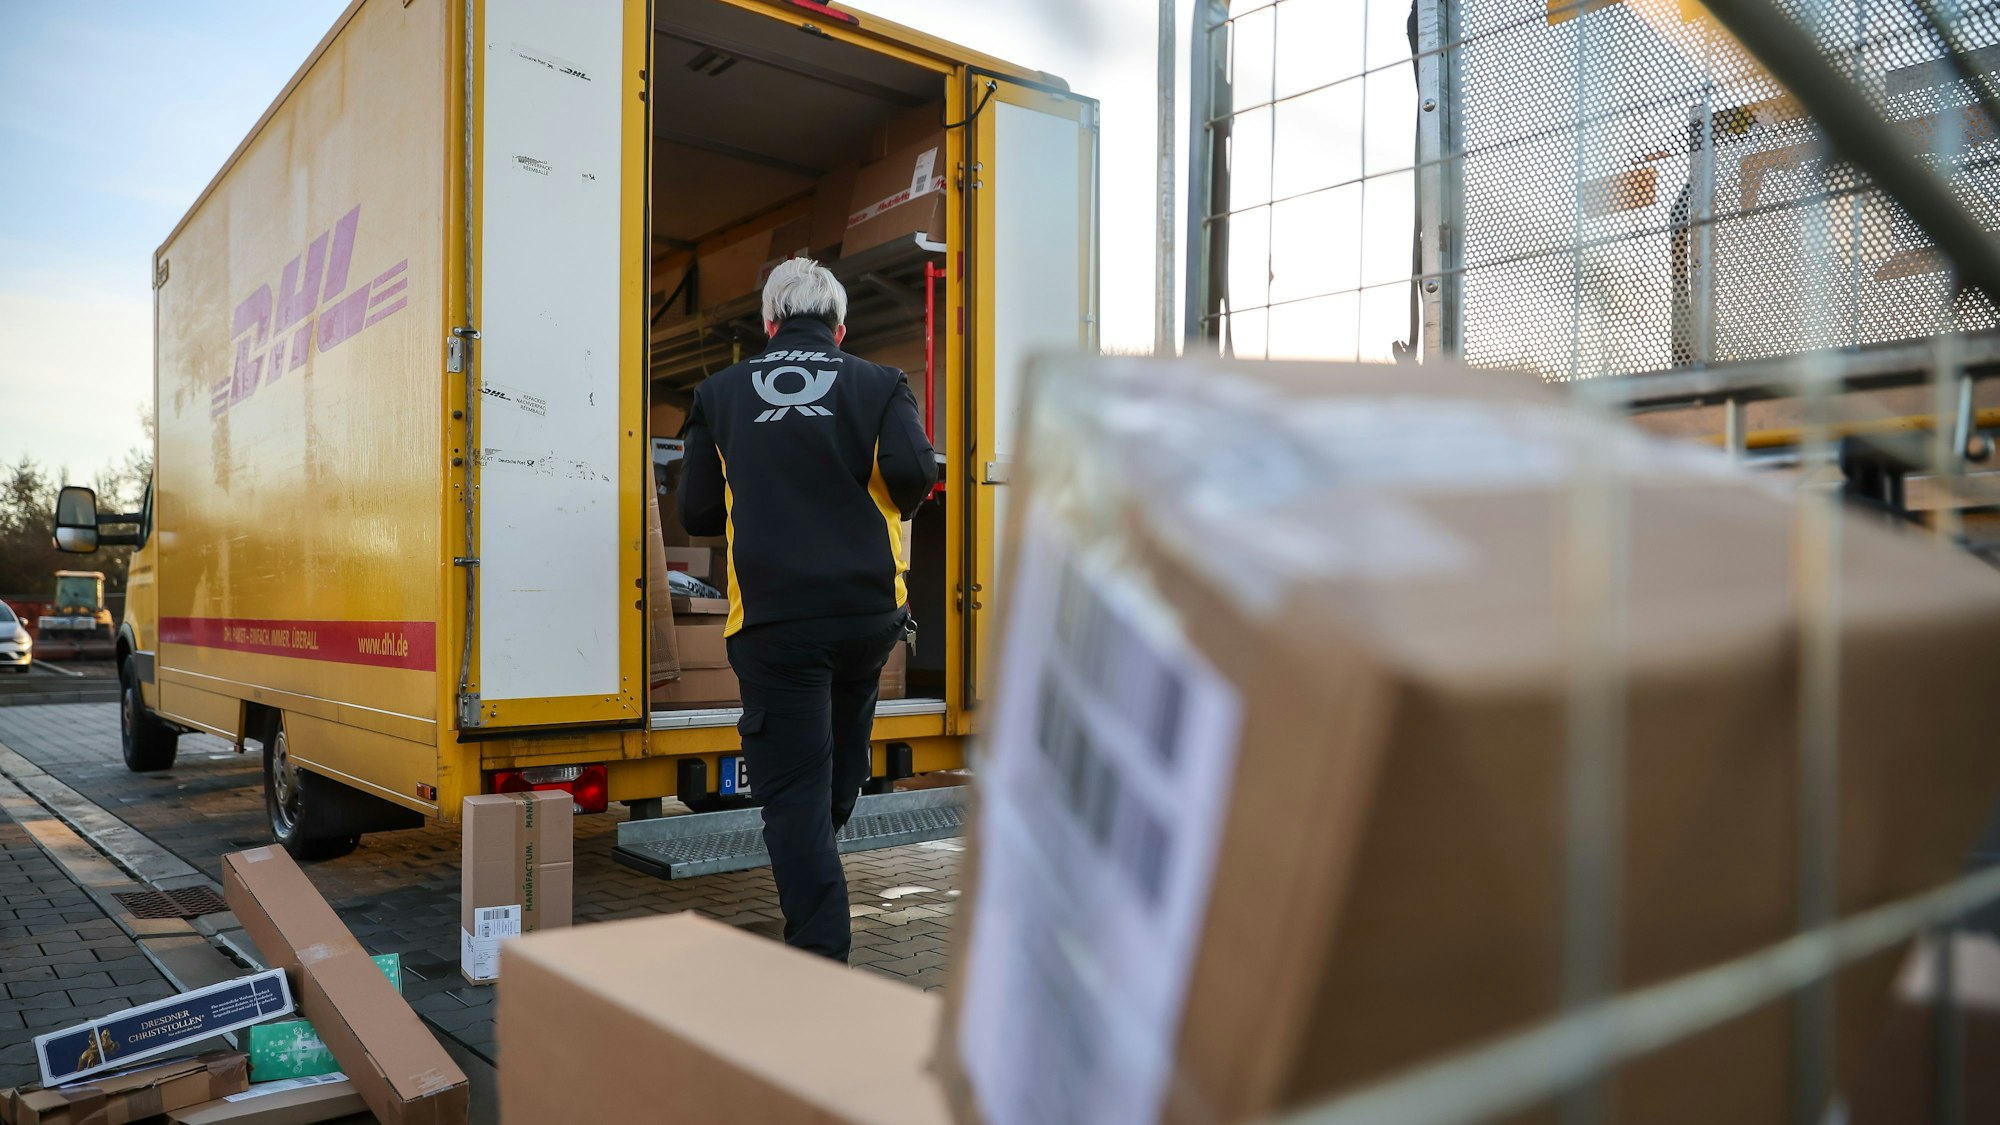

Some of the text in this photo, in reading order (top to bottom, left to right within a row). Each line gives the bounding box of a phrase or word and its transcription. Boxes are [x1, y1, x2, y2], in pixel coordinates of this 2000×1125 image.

[226, 203, 376, 408] DHL
[758, 349, 835, 363] DHL
[481, 387, 508, 401] DHL
[357, 632, 409, 657] www.dhl.de
[725, 779, 732, 788] D
[141, 1010, 190, 1030] DRESDNER
